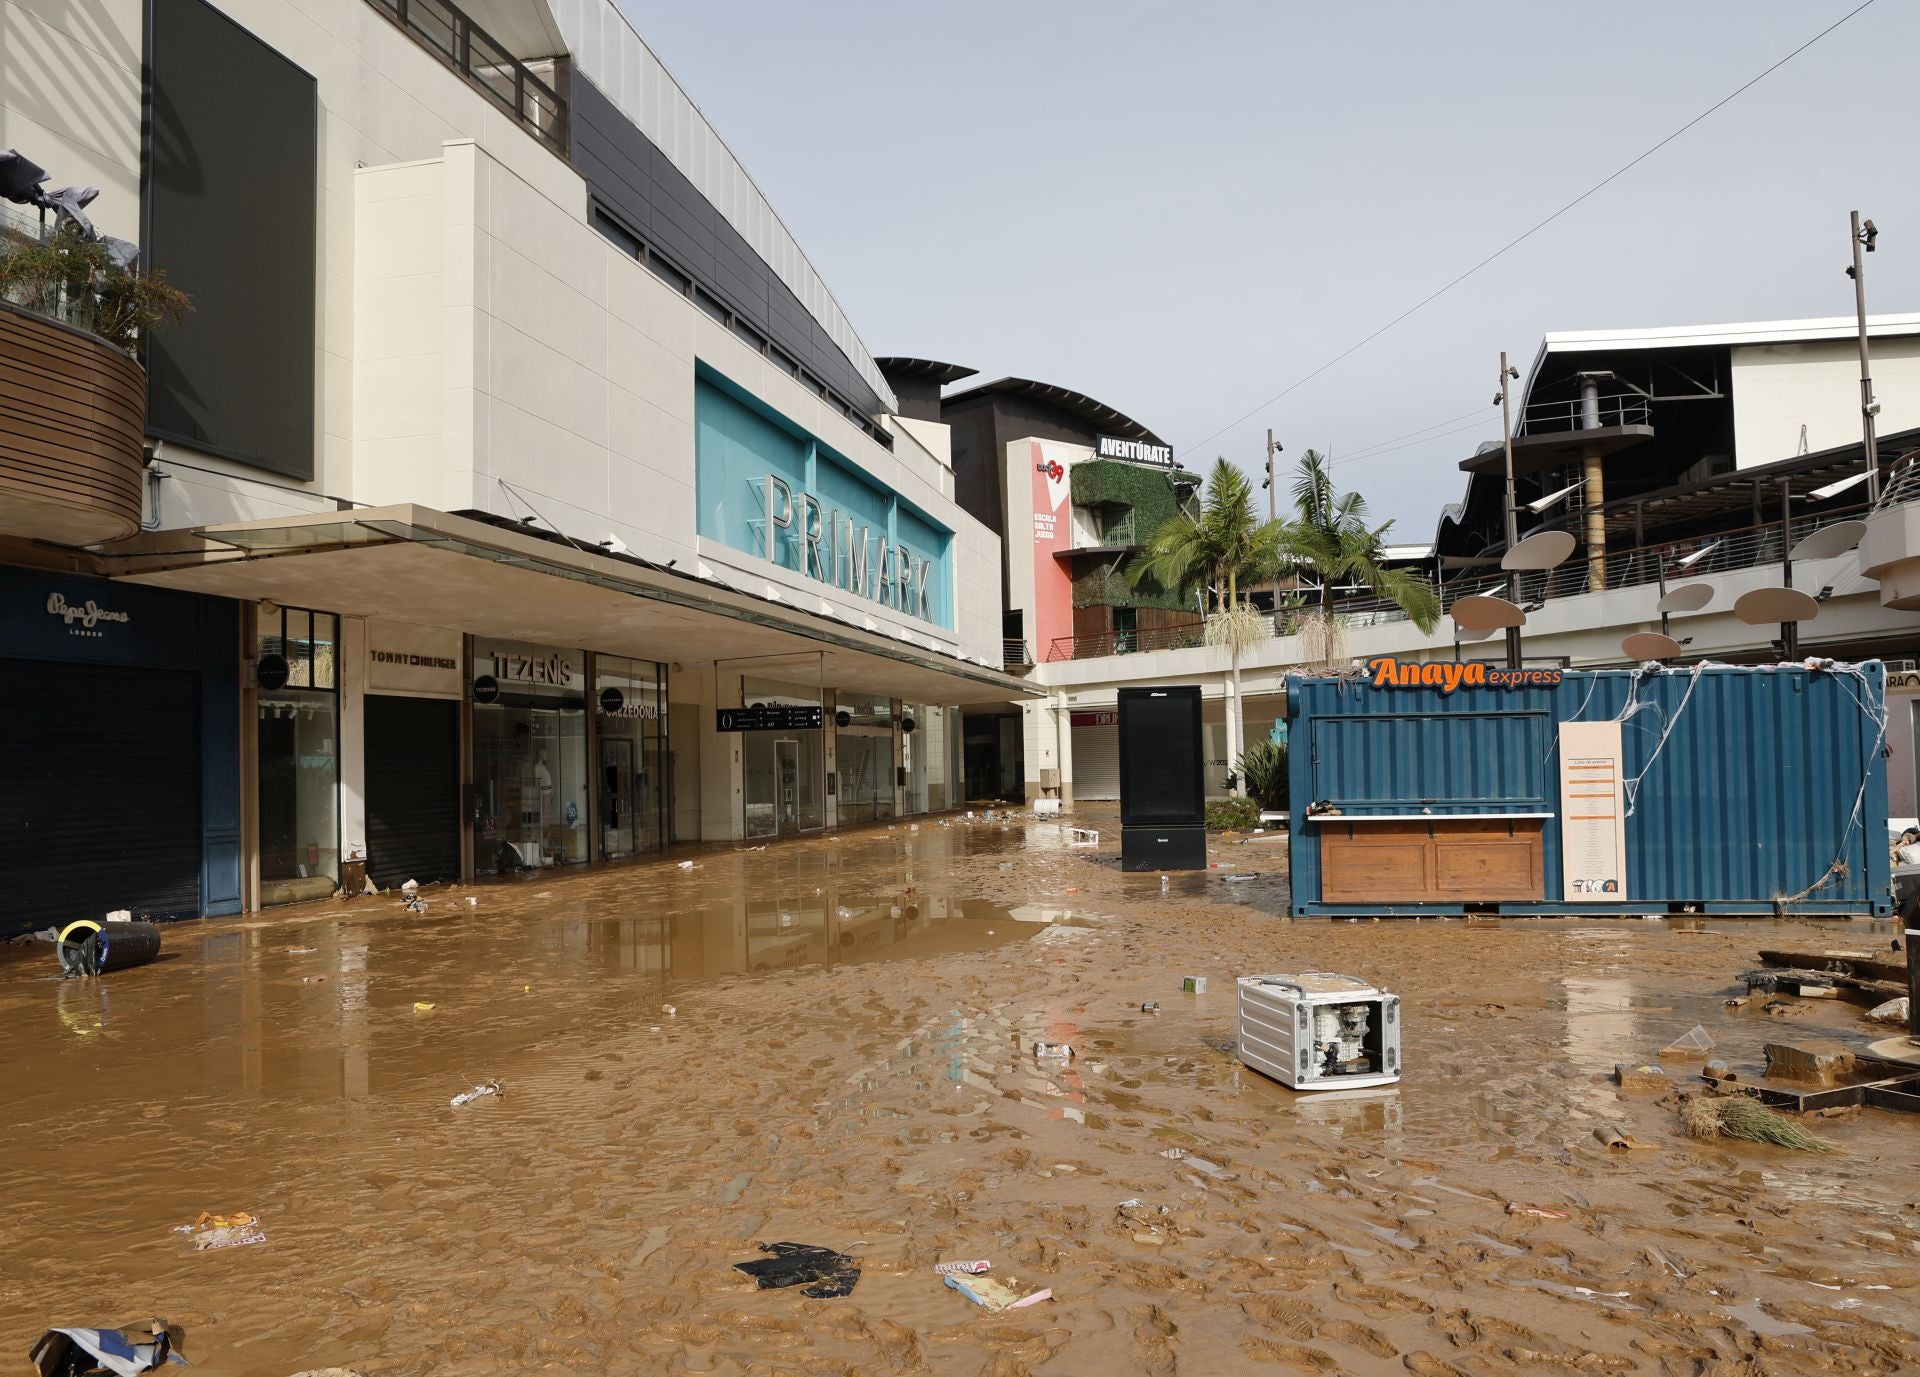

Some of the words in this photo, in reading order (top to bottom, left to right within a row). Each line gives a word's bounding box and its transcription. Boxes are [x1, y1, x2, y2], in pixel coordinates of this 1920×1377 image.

[1101, 437, 1170, 464] AVENTÚRATE
[1034, 513, 1056, 523] ESCALA
[1034, 522, 1054, 531] SALTA
[1035, 530, 1054, 540] JUEGA
[764, 474, 932, 623] PRIMARK
[47, 592, 85, 624] Pepe
[83, 600, 130, 628] Jeans
[70, 629, 103, 637] LONDON
[370, 650, 409, 665] TOMMY
[421, 656, 457, 669] HILFIGER
[491, 652, 572, 686] TEZENIS
[1369, 657, 1486, 693] Anaya
[1488, 669, 1563, 687] express
